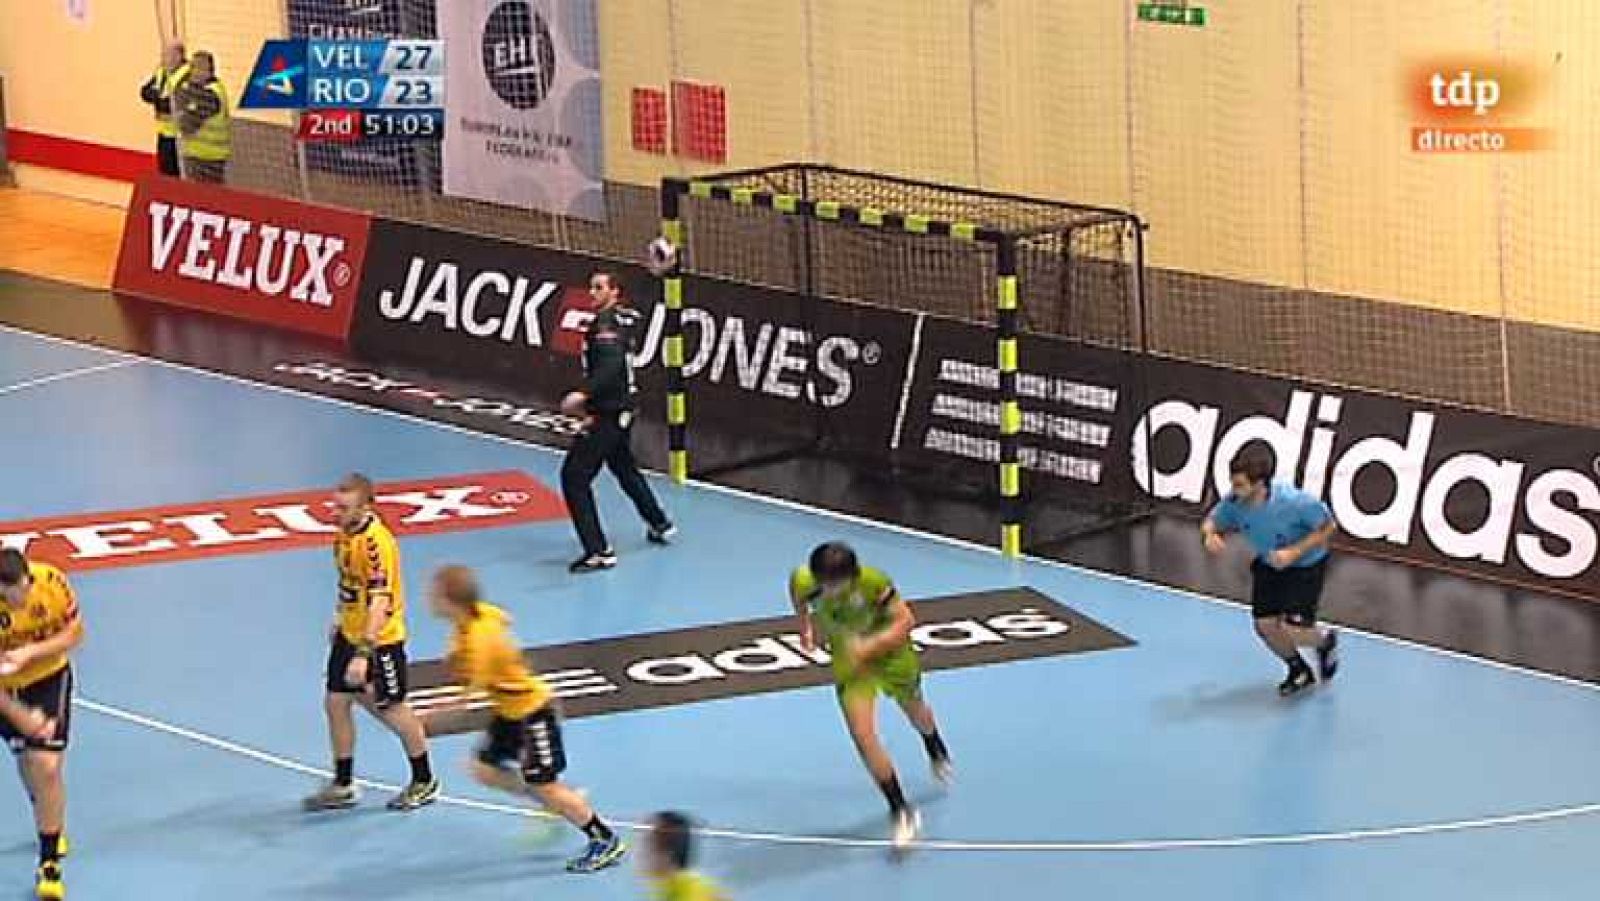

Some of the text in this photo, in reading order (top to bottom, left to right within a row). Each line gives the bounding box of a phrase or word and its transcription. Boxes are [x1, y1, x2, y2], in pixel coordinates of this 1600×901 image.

[149, 202, 345, 307] VELUX
[380, 257, 859, 408] JACK JONES
[0, 485, 518, 559] ELUX
[1131, 389, 1600, 578] adidas
[626, 614, 1070, 683] adias
